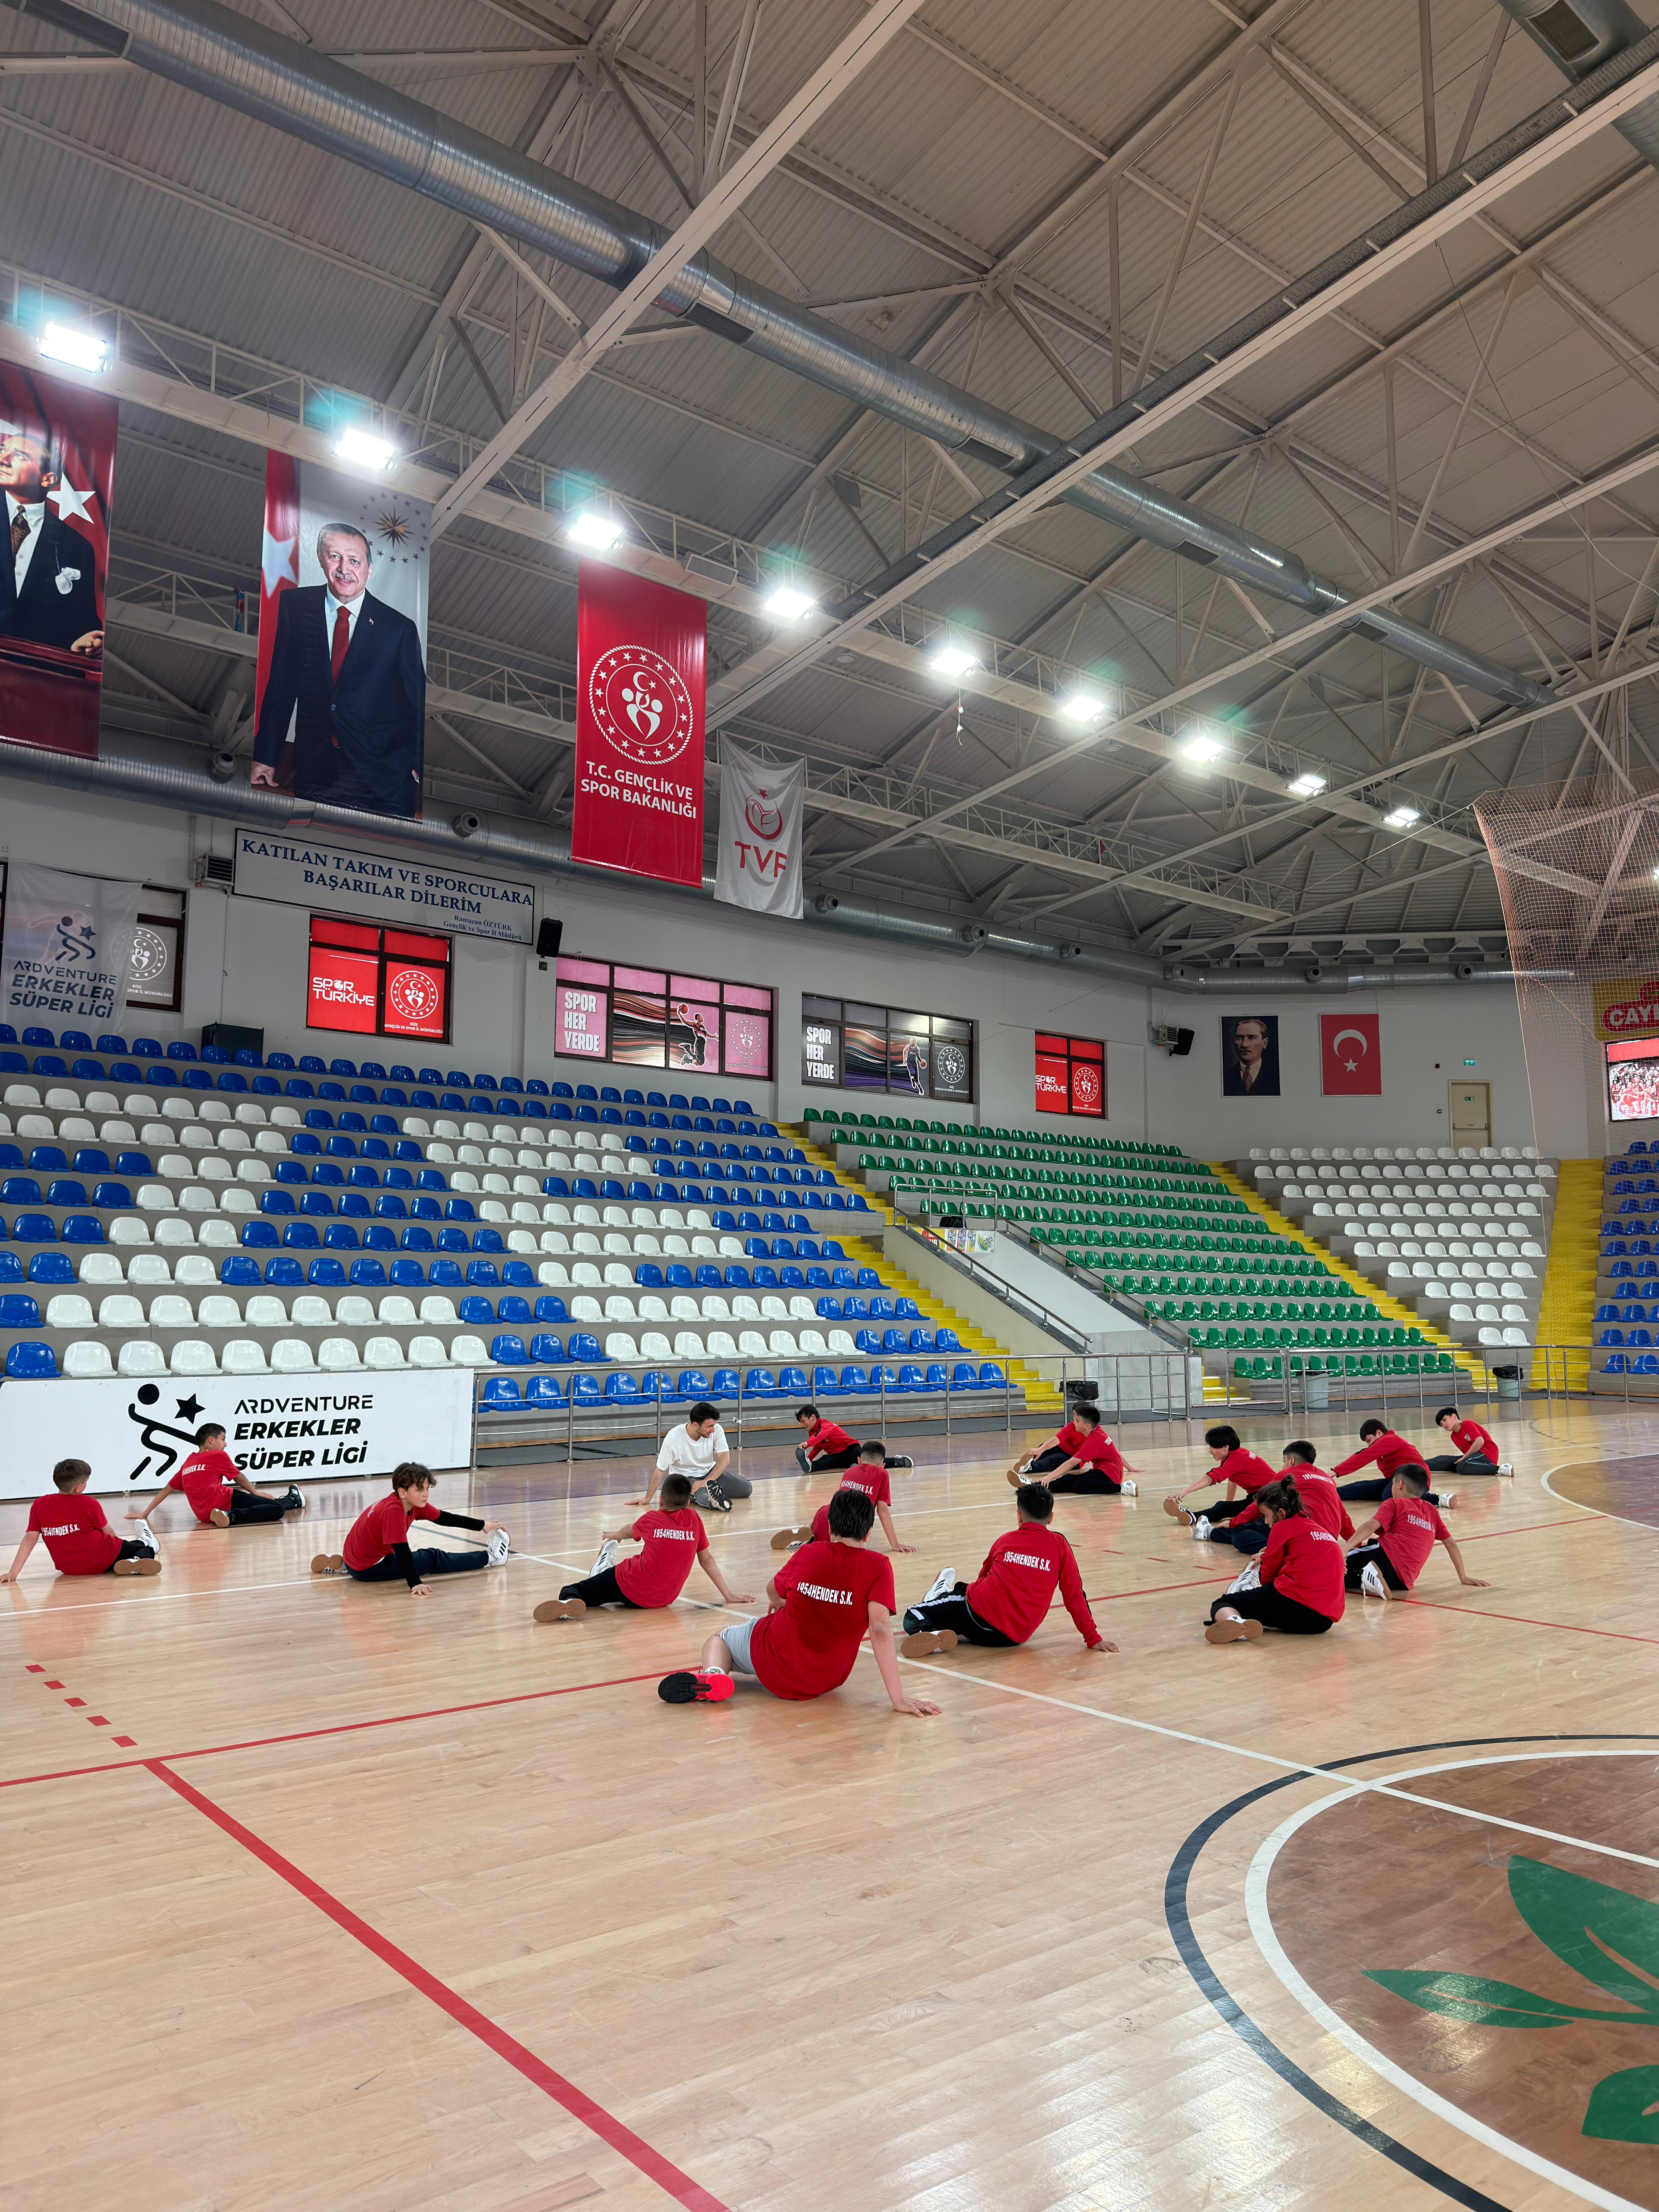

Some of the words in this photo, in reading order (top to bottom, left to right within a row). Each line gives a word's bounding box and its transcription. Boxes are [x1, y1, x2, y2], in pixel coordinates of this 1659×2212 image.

[586, 761, 611, 779] T.C.
[614, 769, 674, 795] GENÇLİK
[676, 785, 693, 800] VE
[581, 779, 619, 800] SPOR
[623, 789, 696, 819] BAKANLIĞI
[734, 841, 787, 878] TVF
[242, 839, 327, 867] KATILAN
[333, 856, 393, 879] TAKIM
[398, 870, 420, 884] VE
[425, 874, 533, 906] SPORCULARA
[304, 870, 405, 900] BAŞARILAR
[411, 889, 481, 914] DİLERİM
[444, 921, 466, 930] Gençlik
[498, 931, 521, 940] Müdürü
[454, 915, 482, 925] Ramazan
[483, 920, 512, 931] ÖZTÜRK
[13, 960, 117, 985] ARDVENTURE
[11, 974, 114, 1001] ERKEKLER
[313, 977, 354, 992] SPOR
[9, 991, 73, 1013] SÜPER
[77, 999, 114, 1019] LİGİ
[312, 988, 375, 1007] TÜRKİYE
[565, 991, 597, 1013] SPOR
[564, 1011, 587, 1031] HER
[564, 1030, 600, 1052] YERDE
[807, 1026, 832, 1045] SPOR
[806, 1044, 824, 1061] HER
[806, 1061, 835, 1080] YERDE
[1036, 1075, 1056, 1084] SPOR
[1036, 1082, 1066, 1094] TÜRKİYE
[234, 1395, 373, 1415] ARDVENTURE
[234, 1418, 361, 1441] ERKEKLER
[234, 1448, 315, 1470] SÜPER
[321, 1440, 369, 1466] LİGİ
[70, 1524, 80, 1533] S.K.
[653, 1528, 685, 1540] 1954HENDEK
[686, 1531, 695, 1541] S.K.
[1003, 1551, 1039, 1570] 1954HENDEK
[1039, 1559, 1050, 1572] S.K.
[797, 1582, 839, 1604] 1954HENDEK
[840, 1591, 853, 1605] S.K.
